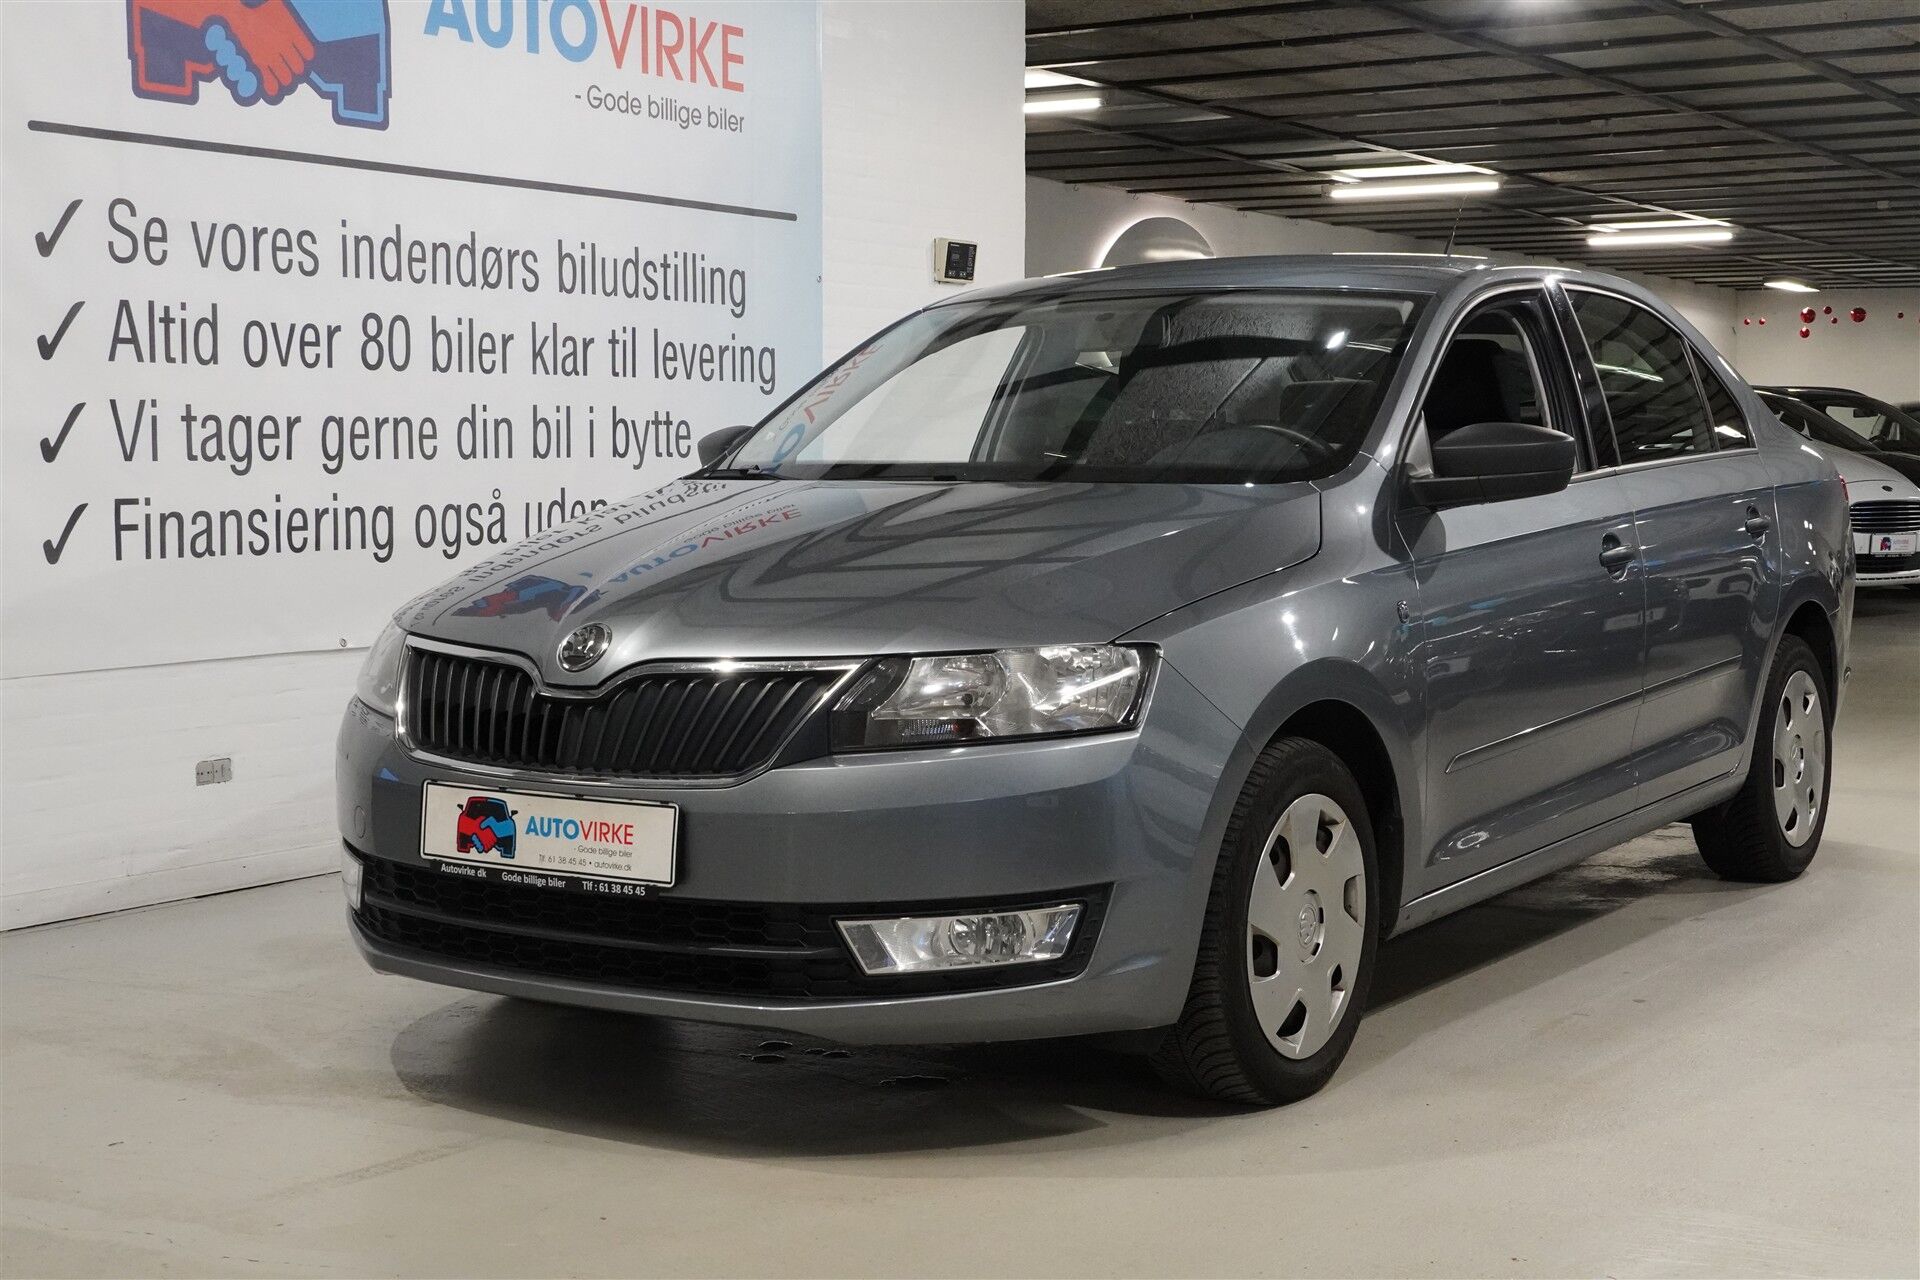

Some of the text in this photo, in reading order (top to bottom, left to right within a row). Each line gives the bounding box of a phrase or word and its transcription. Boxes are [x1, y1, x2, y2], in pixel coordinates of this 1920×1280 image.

[587, 85, 642, 116] Gode
[648, 95, 702, 129] billige
[707, 105, 745, 133] biler
[107, 198, 746, 318] Se vores indendørs biludstilling
[108, 299, 777, 395] Altid over 80 biler klar til levering
[109, 398, 692, 476] Vi tager gerne din bil i bytte
[114, 492, 394, 563] Finansiering
[415, 488, 509, 559] også
[525, 816, 634, 845] AUTOVIRKE
[577, 845, 632, 858] Gode billige biler
[440, 863, 475, 877] Autovirke
[502, 872, 522, 882] Gode
[524, 874, 546, 887] billige
[548, 877, 566, 888] biler
[599, 882, 609, 892] 61
[611, 884, 621, 893] 38
[623, 885, 633, 895] 45
[635, 886, 645, 896] 45
[568, 858, 576, 866] 45
